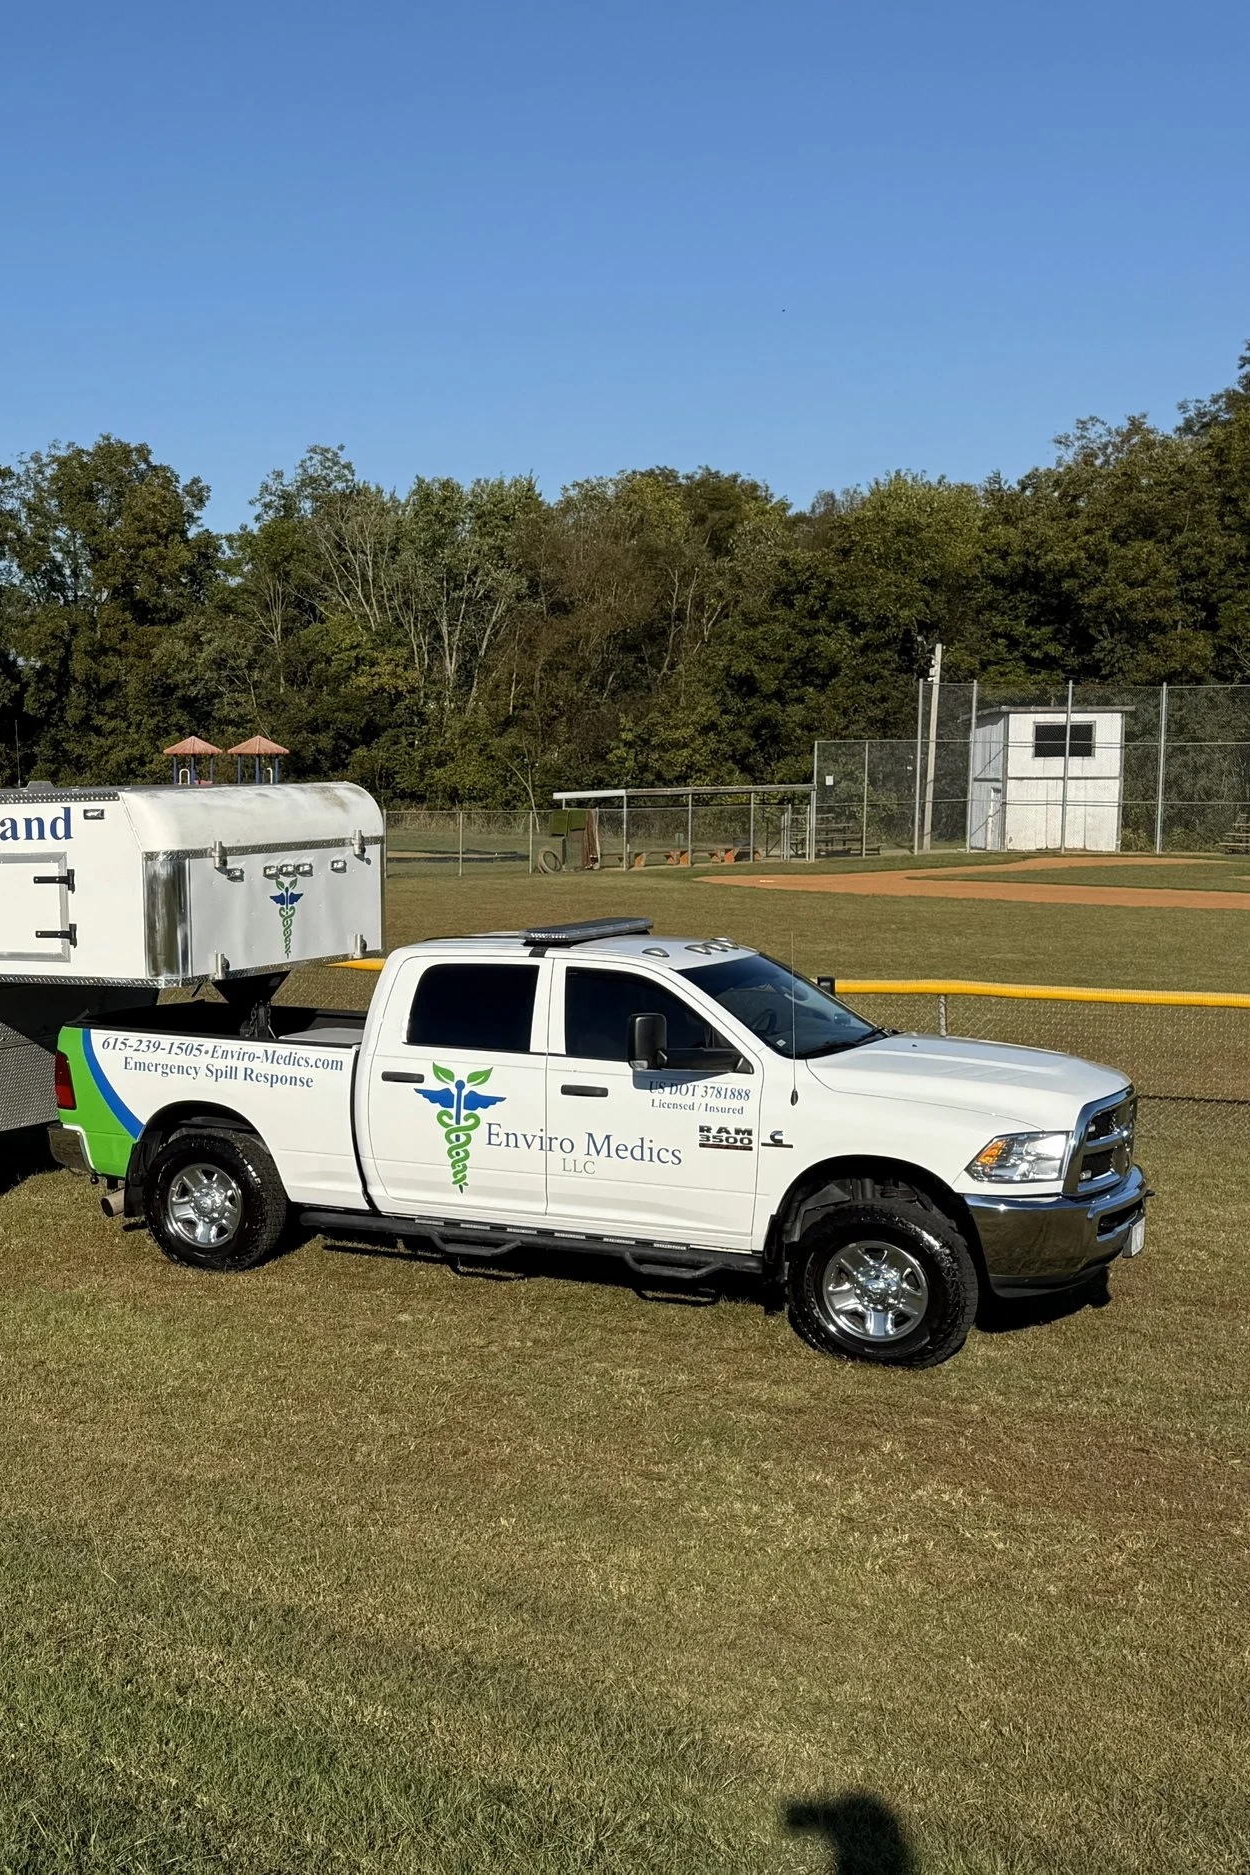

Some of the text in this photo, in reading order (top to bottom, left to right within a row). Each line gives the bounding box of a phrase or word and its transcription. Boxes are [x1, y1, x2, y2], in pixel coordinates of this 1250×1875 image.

[123, 1056, 314, 1088] Emergency Spill Response
[649, 1081, 751, 1101] US DOT 3781888
[651, 1099, 695, 1111] Licensed
[705, 1103, 744, 1115] Insured
[699, 1125, 753, 1137] RAM
[486, 1122, 682, 1166] Enviro Medics
[699, 1134, 753, 1146] 3500
[562, 1158, 595, 1175] LLC
